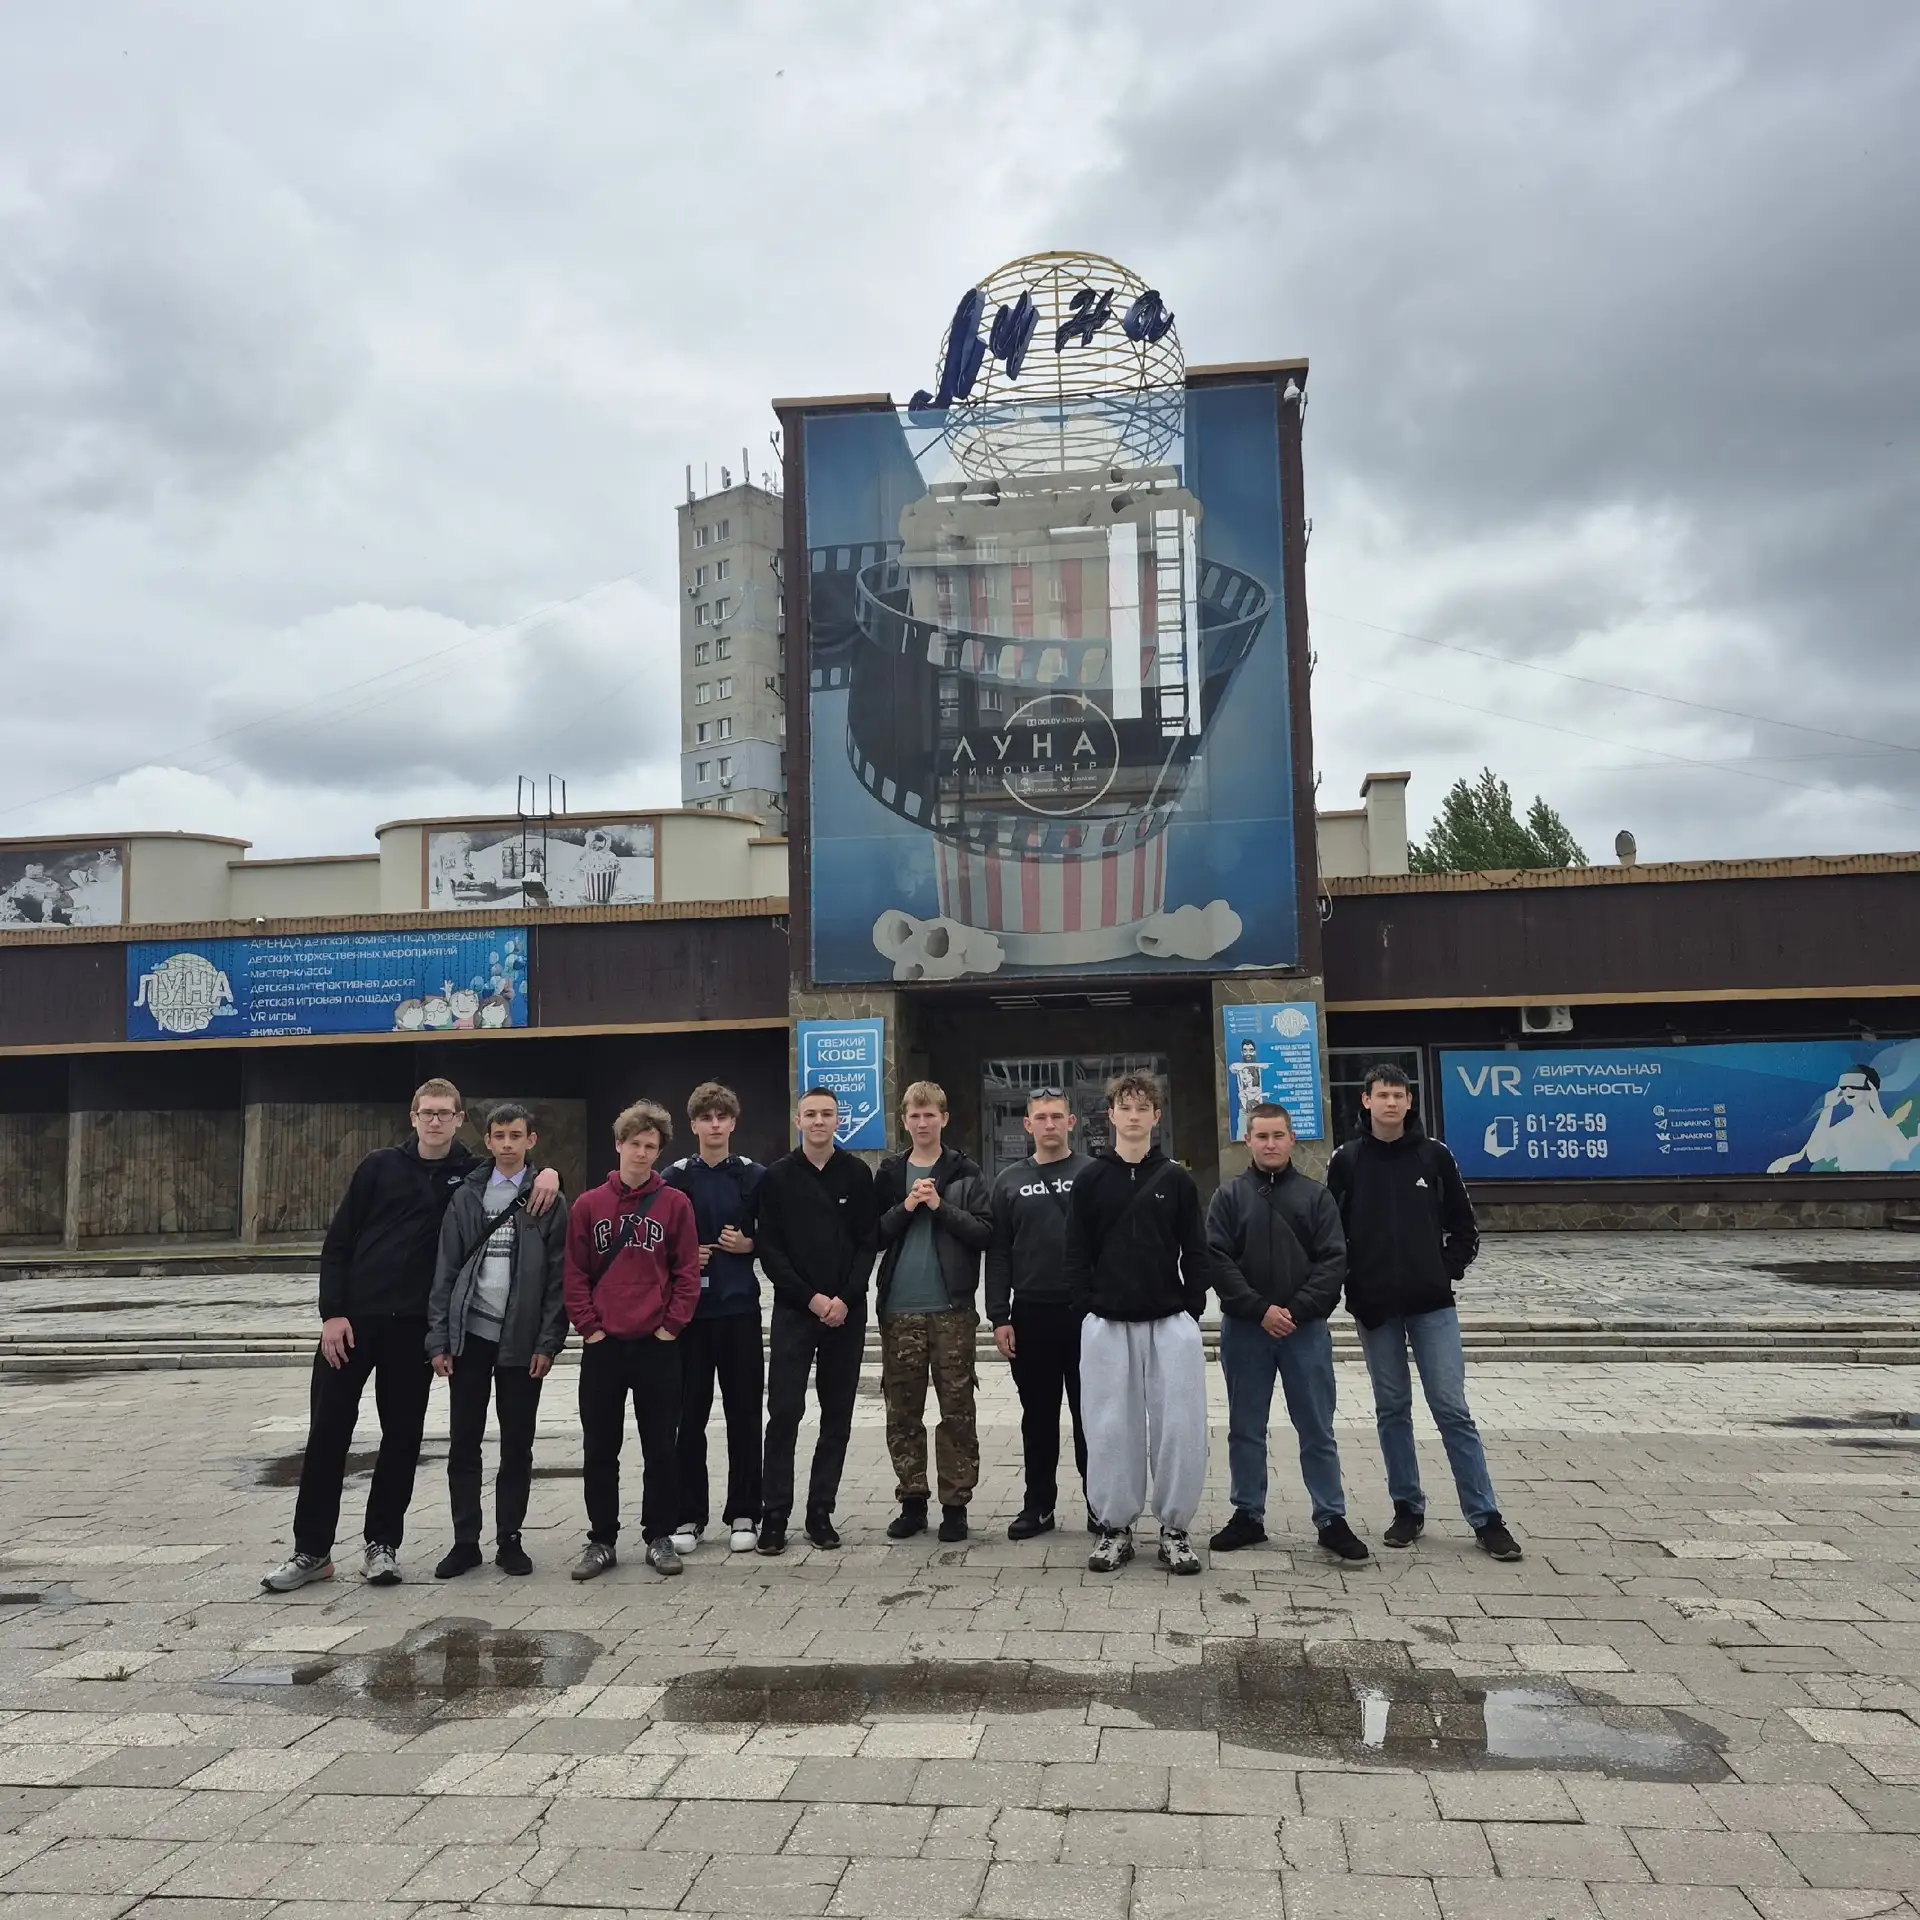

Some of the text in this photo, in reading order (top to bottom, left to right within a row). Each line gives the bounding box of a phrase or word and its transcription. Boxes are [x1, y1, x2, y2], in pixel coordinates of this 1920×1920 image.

[952, 730, 1096, 762] ЛУНА
[952, 761, 1097, 777] КИНОЦЕНТР
[250, 930, 496, 949] АРЕНДА детской комнаты под проведение
[248, 945, 458, 965] детских торжественных мероприятий
[250, 966, 333, 978] мастер-классы
[133, 970, 234, 1007] ЛУНА
[250, 978, 416, 994] детская интерактивная доска
[250, 993, 402, 1009] детская игровая площадка
[158, 1007, 210, 1031] KIDS
[250, 1012, 297, 1023] VR игры
[250, 1026, 312, 1037] аниматоры
[817, 1036, 866, 1048] СВЕЖИЙ
[818, 1048, 867, 1062] КОФЕ
[818, 1072, 866, 1083] ВОЗЬМИ
[1456, 1065, 1523, 1097] VR
[828, 1081, 866, 1092] СОБОЙ
[1526, 1113, 1607, 1133] 61-25-59
[1670, 1119, 1711, 1127] LUNAKINO
[1672, 1132, 1713, 1140] LUNAKINO
[1527, 1139, 1608, 1159] 61-36-69
[1020, 1178, 1074, 1197] adda
[593, 1213, 664, 1255] GAP
